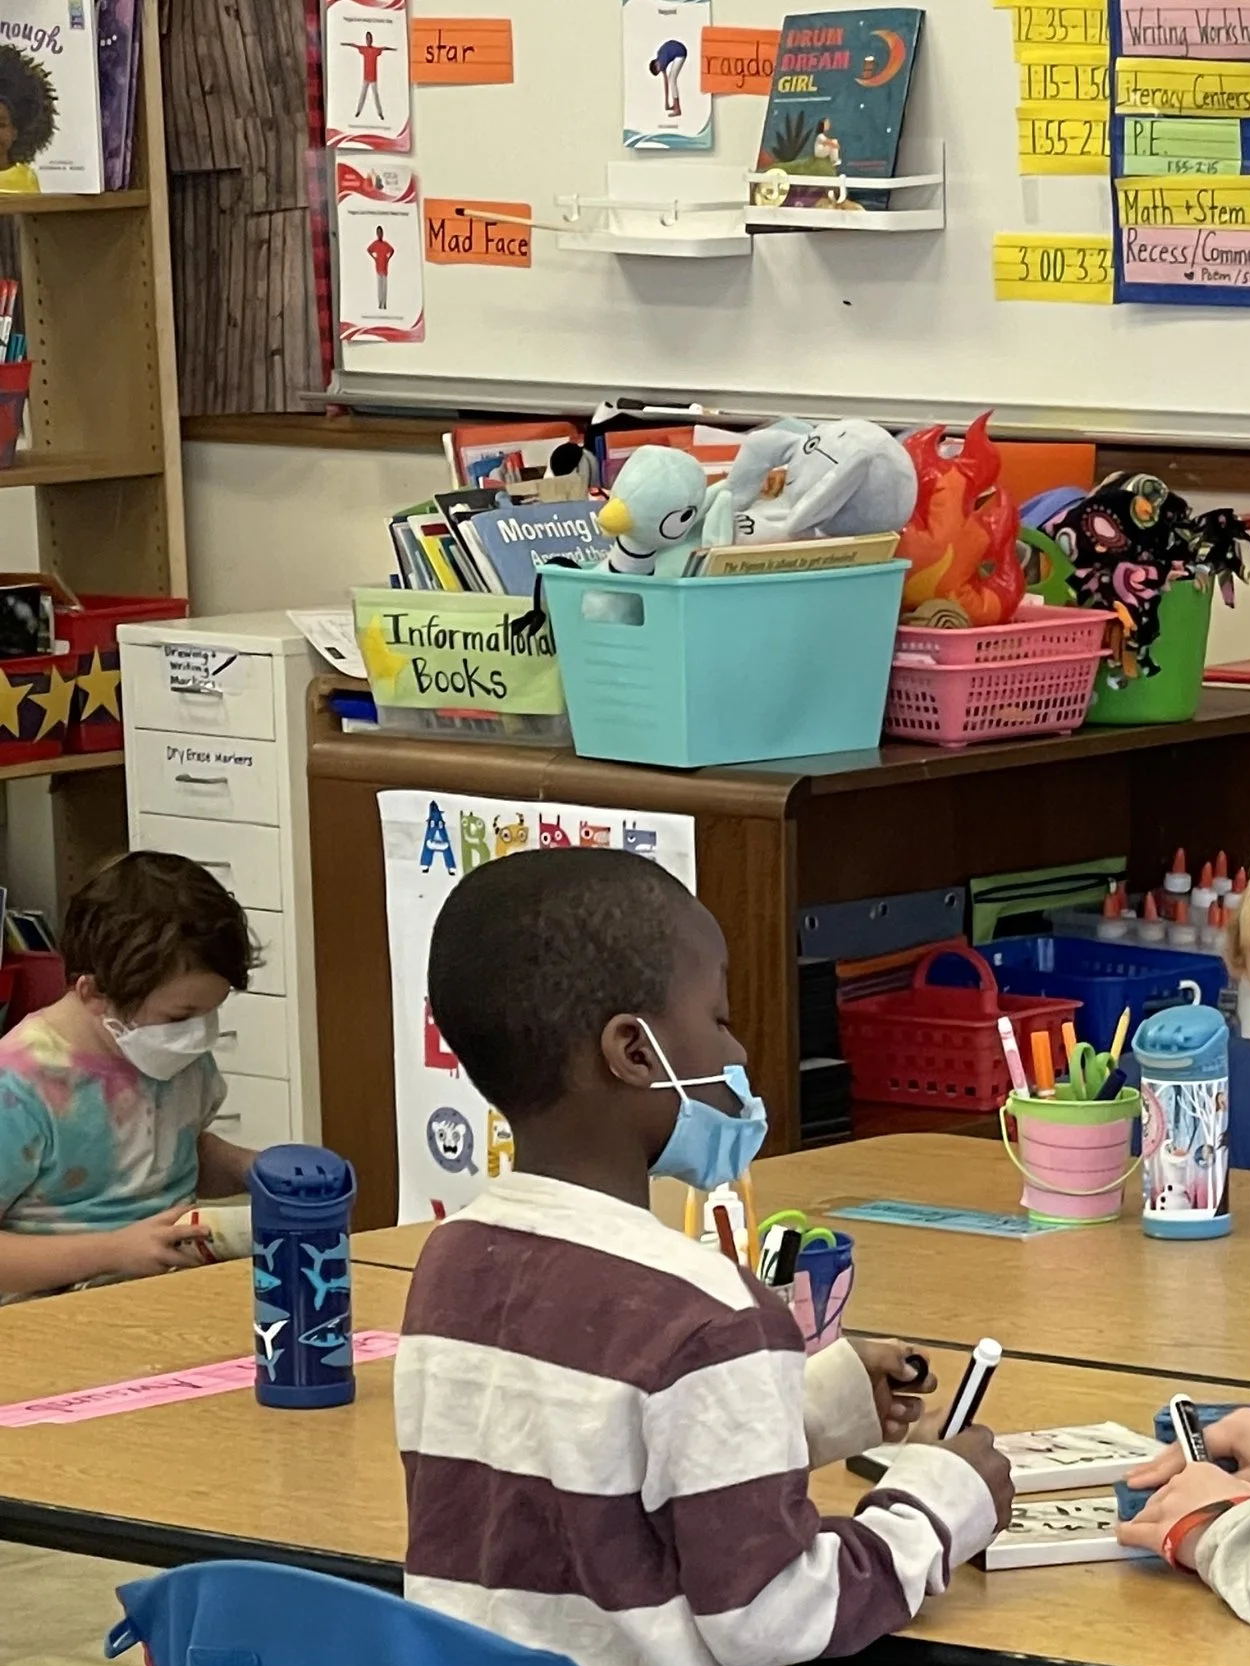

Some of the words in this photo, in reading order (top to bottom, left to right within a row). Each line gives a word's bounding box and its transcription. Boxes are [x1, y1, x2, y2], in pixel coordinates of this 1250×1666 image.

[785, 27, 844, 48] DRUM
[1016, 7, 1109, 43] 12:35-1:1
[1126, 8, 1189, 57] Writing
[425, 29, 475, 63] star
[704, 40, 774, 88] ragdo
[780, 51, 851, 71] DREAM
[777, 75, 818, 93] GIRL
[1033, 120, 1110, 157] 1:55-2:1
[1134, 121, 1168, 156] P.E.
[1124, 187, 1173, 225] Math
[428, 218, 473, 253] Mad
[484, 222, 528, 256] Face
[1019, 247, 1114, 283] 3:00-3:3
[497, 515, 591, 544] Morning
[411, 657, 507, 699] Books
[167, 745, 184, 764] Dry
